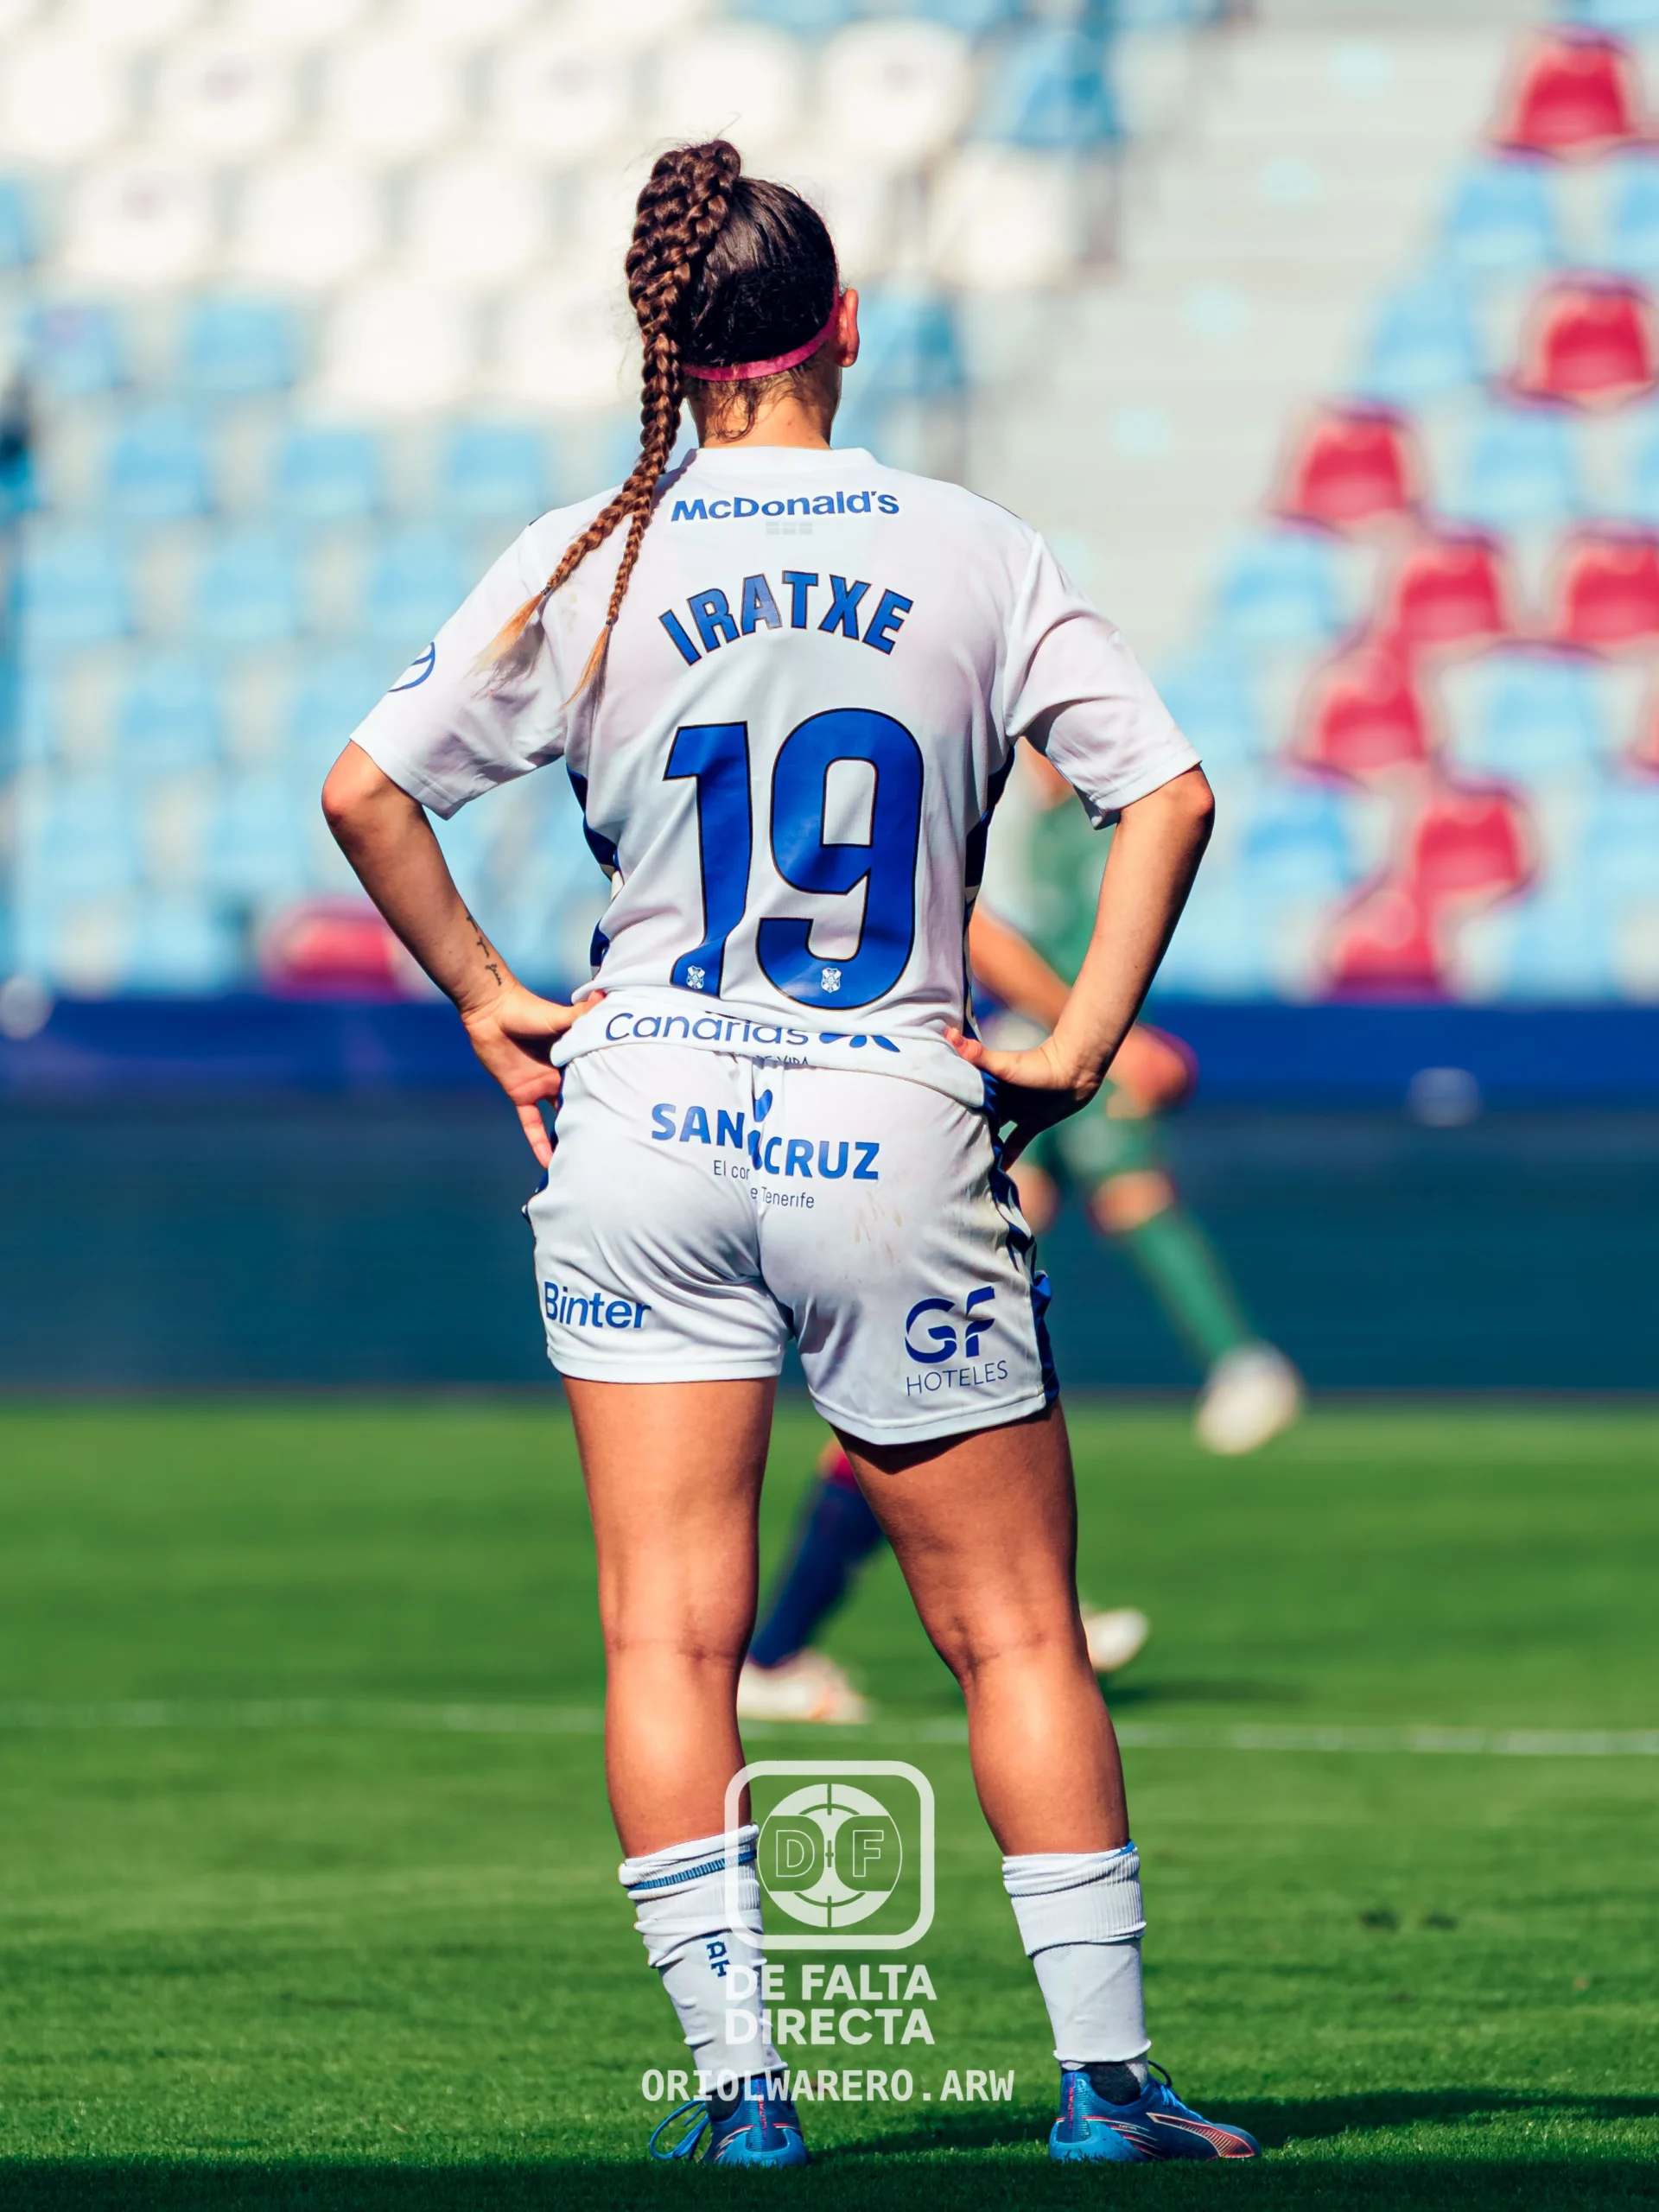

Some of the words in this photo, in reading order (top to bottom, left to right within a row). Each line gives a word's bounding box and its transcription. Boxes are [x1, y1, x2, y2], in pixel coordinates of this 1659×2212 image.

[671, 491, 899, 522] McDonald's
[658, 569, 914, 667] IRATXE
[663, 708, 925, 1011] 19
[606, 1012, 809, 1046] Canarias
[764, 1136, 880, 1180] CRUZ
[714, 1160, 727, 1176] El
[761, 1186, 815, 1209] Tenerife
[544, 1281, 652, 1329] Binter
[905, 1286, 995, 1363] GF
[906, 1360, 1007, 1396] HOTELES
